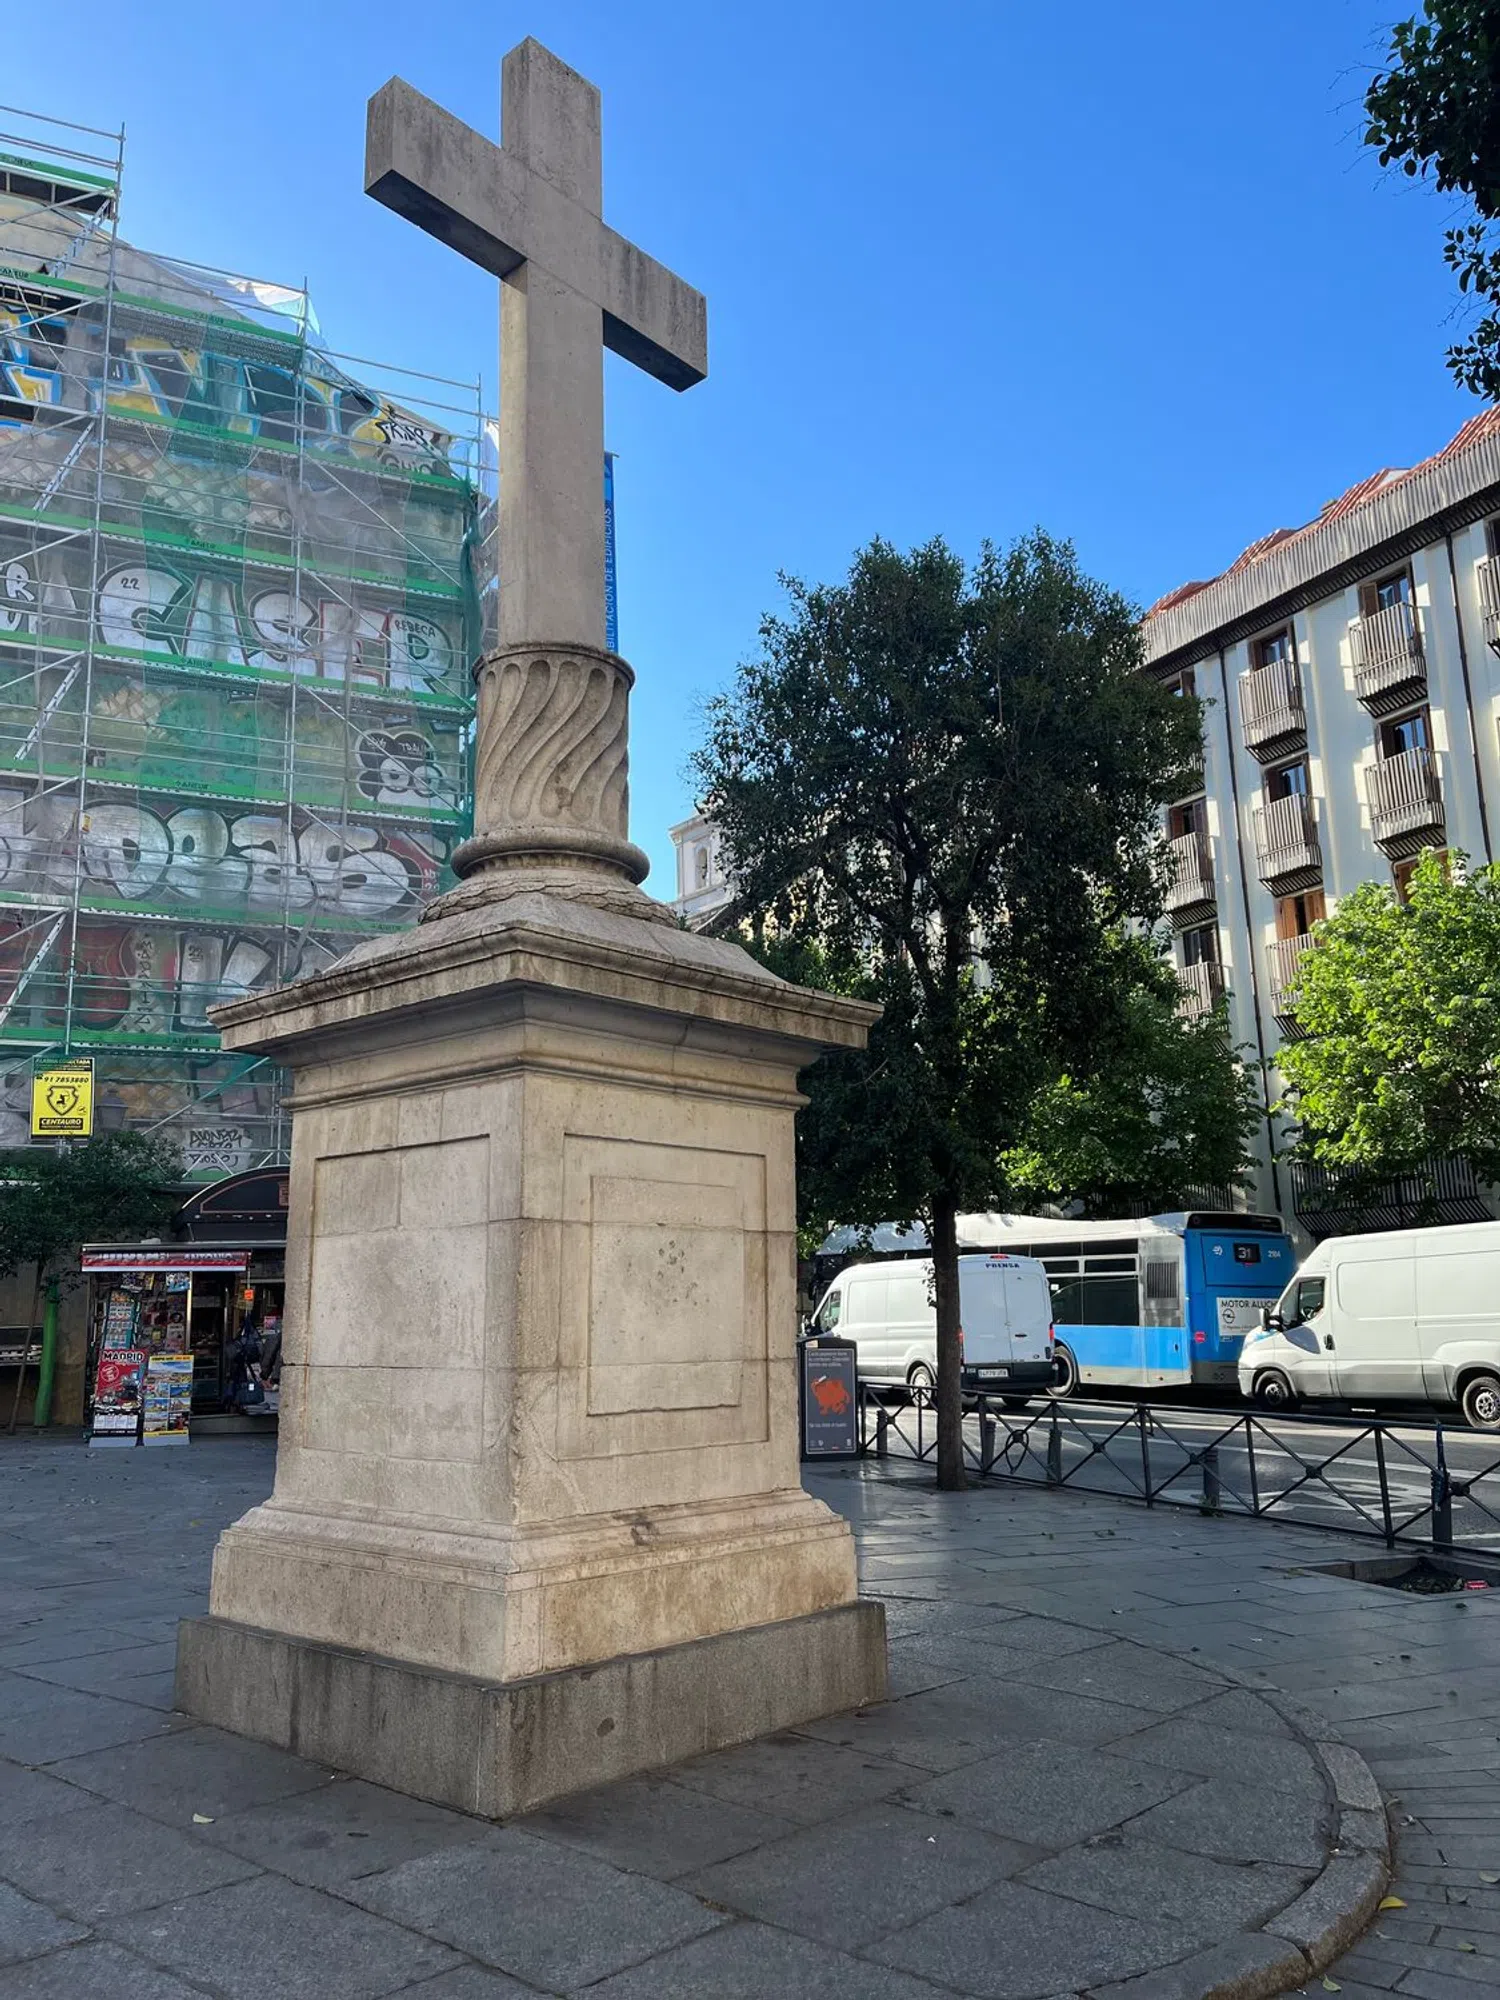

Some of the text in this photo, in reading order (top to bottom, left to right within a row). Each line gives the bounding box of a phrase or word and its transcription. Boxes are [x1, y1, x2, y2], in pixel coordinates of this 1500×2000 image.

[604, 566, 613, 580] DE
[121, 577, 140, 590] 22
[395, 619, 436, 638] REBECA
[1238, 1247, 1252, 1259] 31
[1221, 1300, 1278, 1309] MOTOR ALUCH
[102, 1351, 145, 1361] MADRID
